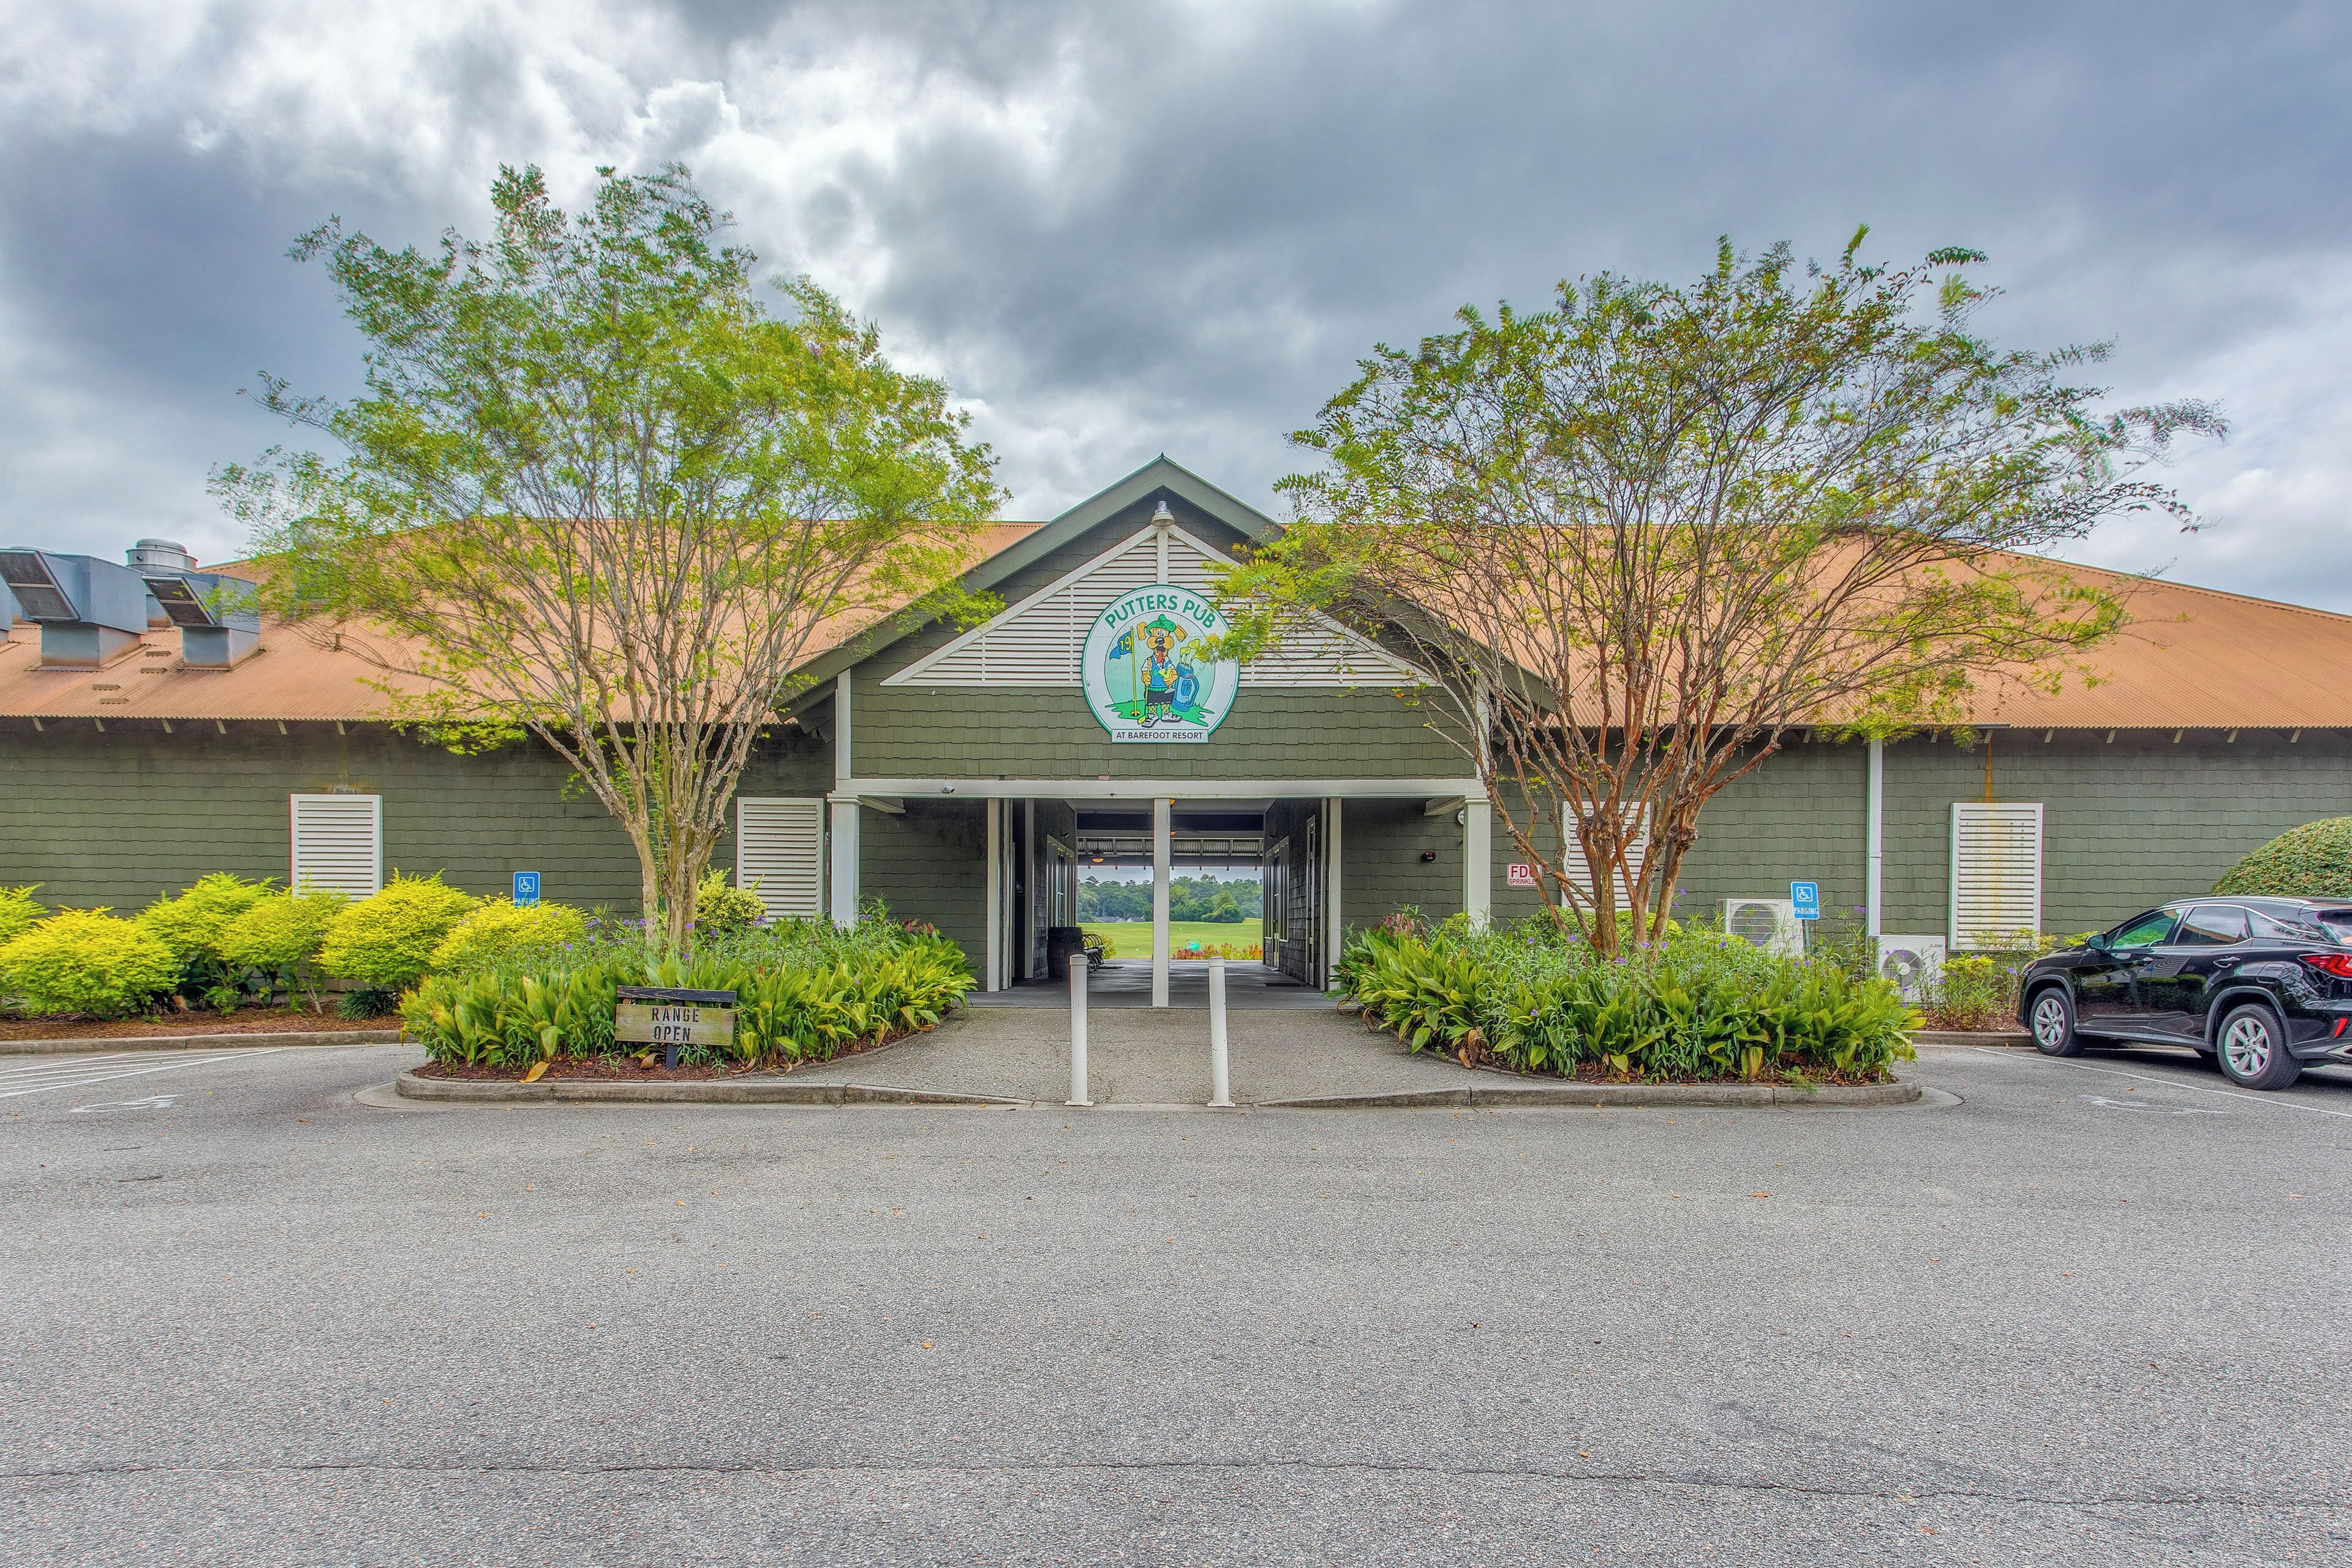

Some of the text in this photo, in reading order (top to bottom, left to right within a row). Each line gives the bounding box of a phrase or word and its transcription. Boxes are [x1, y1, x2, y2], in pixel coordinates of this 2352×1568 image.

[1104, 594, 1216, 630] PUTTERS PUB
[1120, 635, 1132, 651] 19
[652, 1008, 699, 1023] RANGE
[653, 1025, 691, 1042] OPEN
